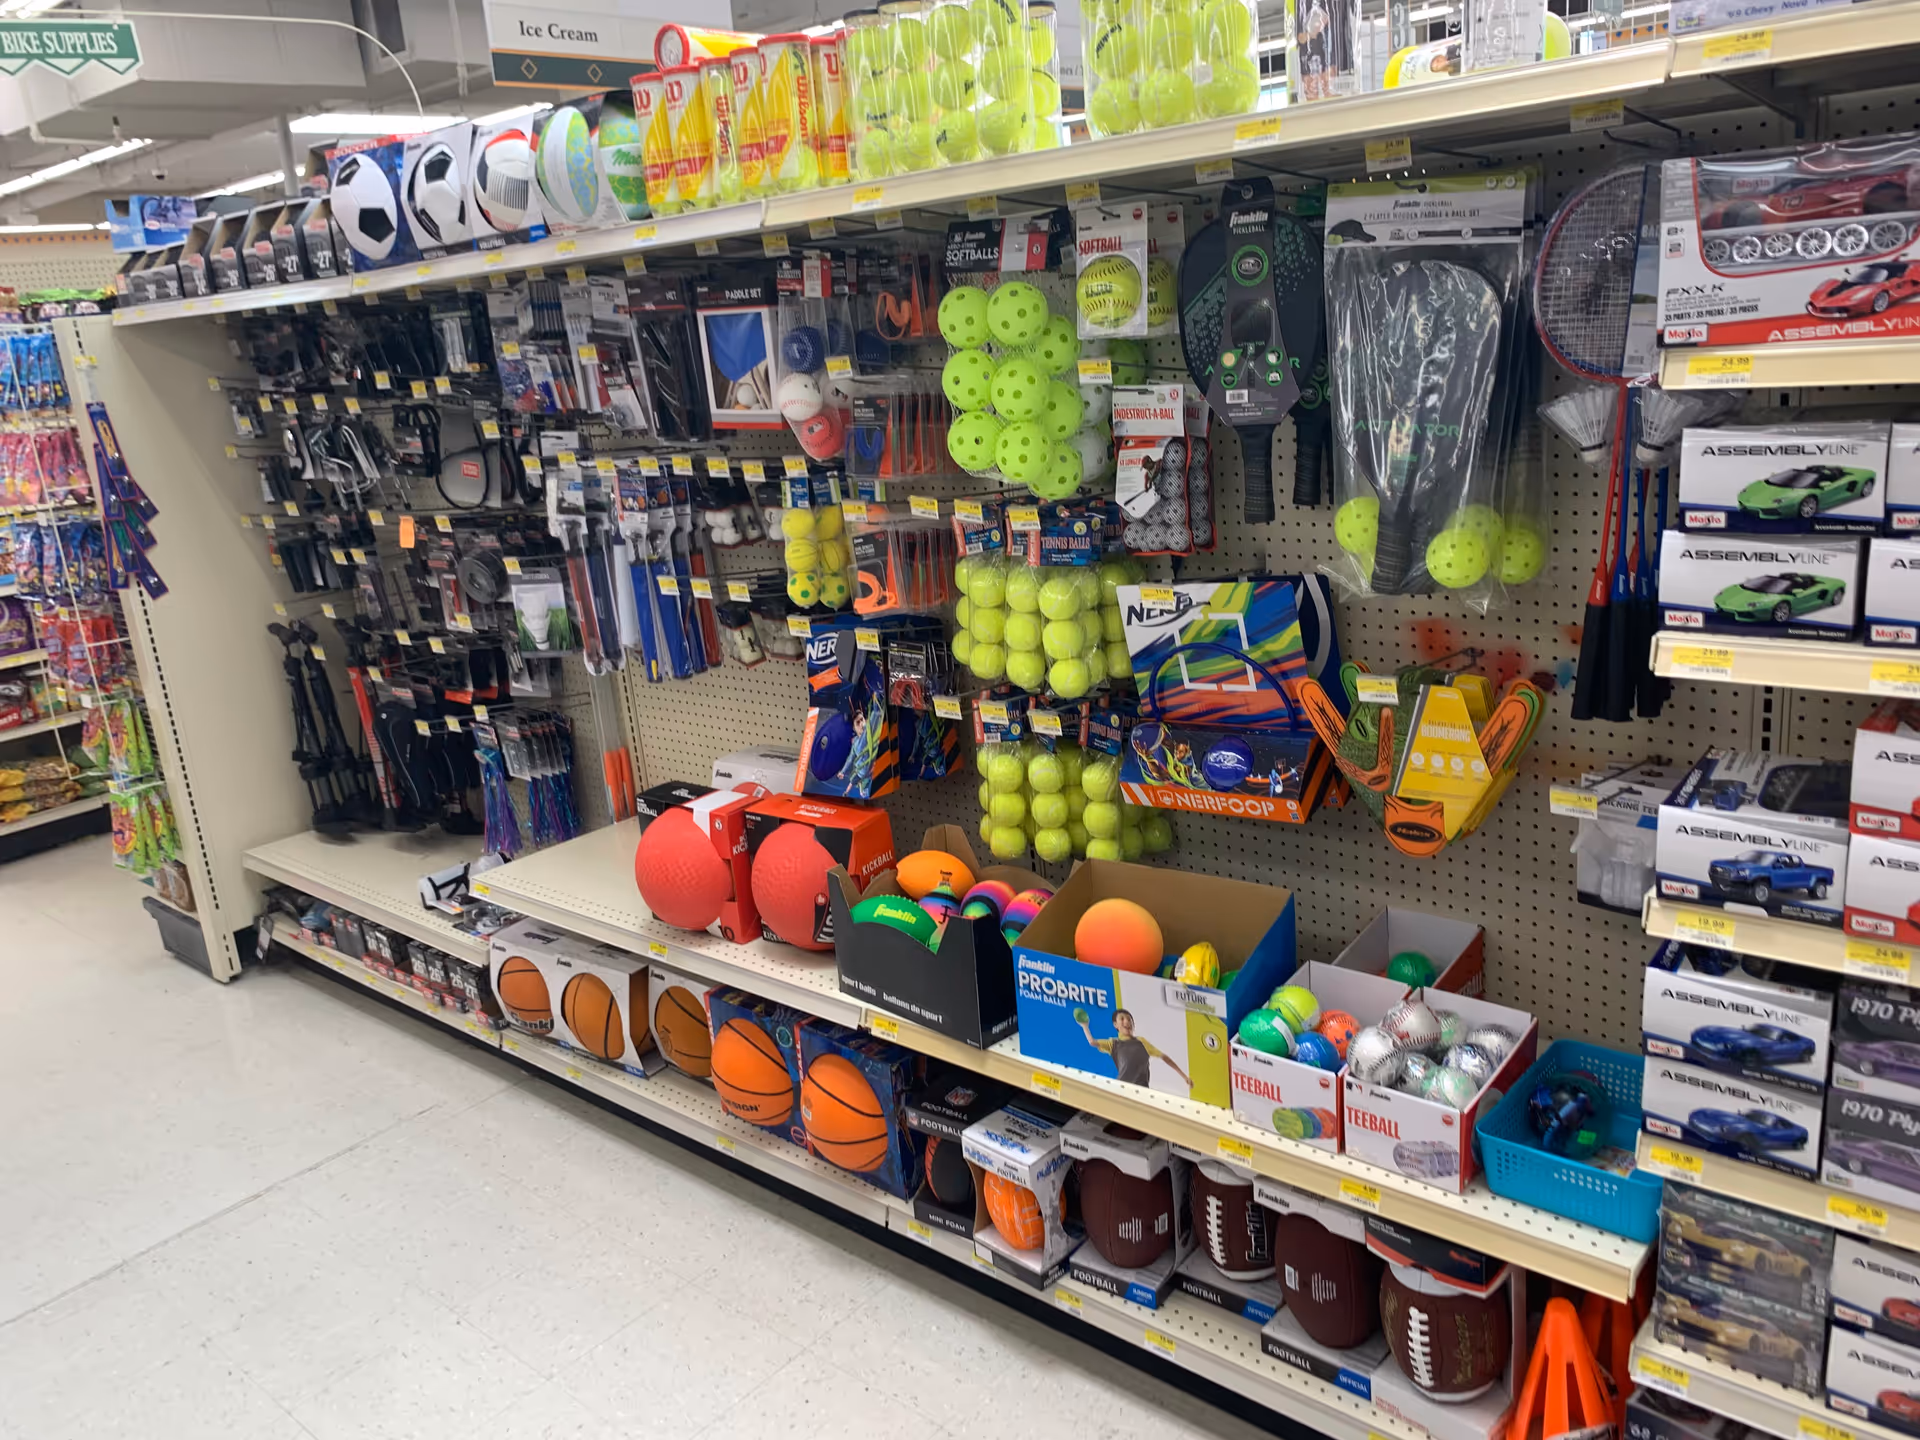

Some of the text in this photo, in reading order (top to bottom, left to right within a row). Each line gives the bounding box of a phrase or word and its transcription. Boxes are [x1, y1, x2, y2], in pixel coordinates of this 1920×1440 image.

[519, 20, 598, 42] Ice Cream
[2, 31, 118, 54] BIKE SUPPLIES
[796, 75, 809, 142] Wilson
[1230, 211, 1268, 228] Franklin
[1233, 225, 1264, 235] PICKLEBALL
[946, 247, 999, 261] SOFTBALLS
[1079, 236, 1122, 255] SOFTBALL
[725, 288, 762, 299] PADDLE SET
[1668, 328, 1703, 341] Maisto
[1114, 408, 1175, 420] INDESTRUCT-A-BALL
[1689, 514, 1721, 525] Maisto
[1041, 537, 1090, 549] TENNIS BALLS
[1668, 614, 1699, 625] Maisto
[1875, 628, 1912, 641] Maisto
[806, 638, 837, 661] NER
[1421, 725, 1471, 742] BOOMERANG
[1177, 793, 1274, 816] NERFOOP
[1860, 816, 1896, 828] Maisto
[861, 851, 893, 875] KICKBALL
[1664, 883, 1695, 896] Maisto
[873, 904, 918, 924] Franklin
[1018, 954, 1055, 974] Franklin
[841, 975, 943, 1023] sport balls ballons de sport
[1018, 971, 1108, 1008] PROBRITE
[1019, 988, 1067, 1008] FOAM BALLS
[1175, 990, 1207, 1005] FUTURE
[1851, 996, 1893, 1019] 1970
[1233, 1072, 1283, 1104] TEEBALL
[1842, 1099, 1883, 1122] 1970
[921, 1117, 963, 1137] FOOTBALL
[1346, 1105, 1401, 1140] TEEBALL
[1063, 1137, 1089, 1153] Franklin
[997, 1167, 1027, 1185] FOOTBALL
[1258, 1188, 1290, 1209] Franklin
[929, 1214, 966, 1232] MINI FOAM
[1074, 1269, 1119, 1295] FOOTBALL
[1183, 1282, 1222, 1304] FOOTBALL
[1269, 1343, 1312, 1371] FOOTBALL
[1339, 1374, 1368, 1393] OFFICIAL
